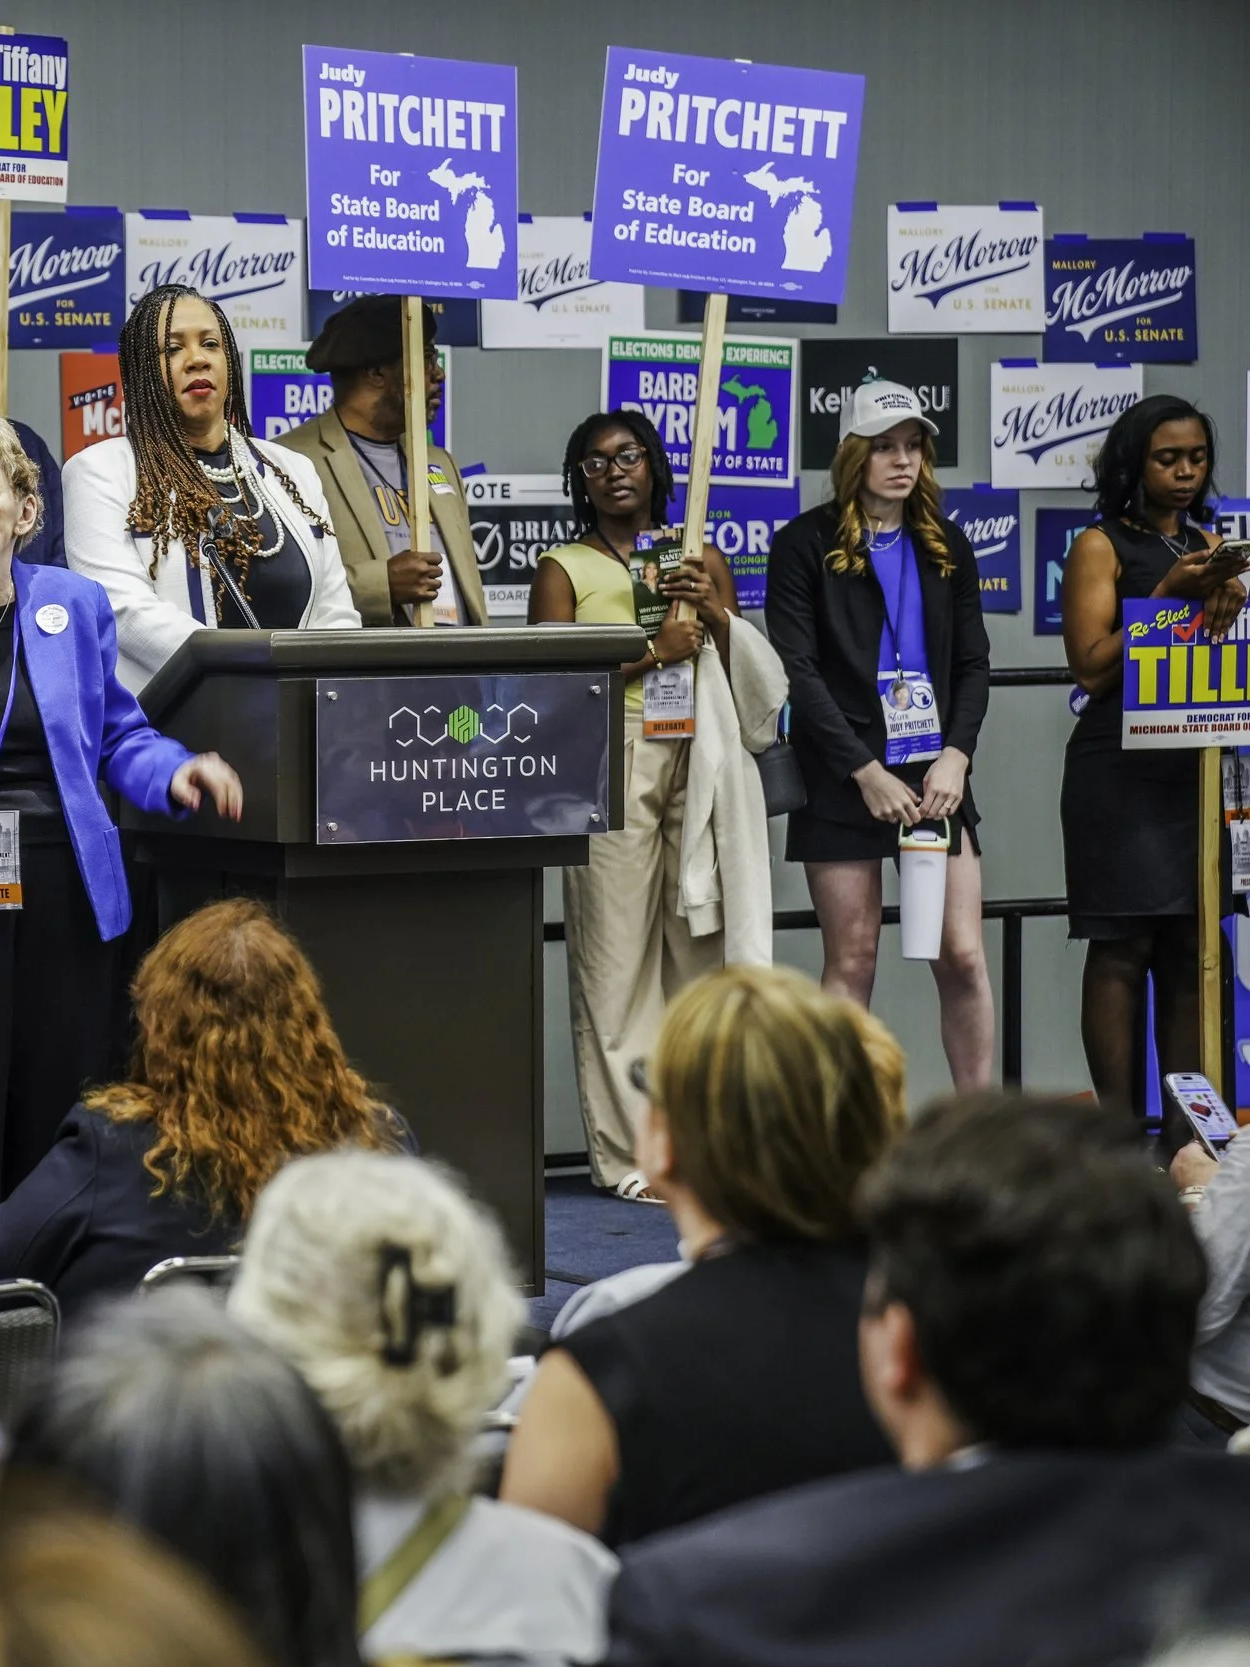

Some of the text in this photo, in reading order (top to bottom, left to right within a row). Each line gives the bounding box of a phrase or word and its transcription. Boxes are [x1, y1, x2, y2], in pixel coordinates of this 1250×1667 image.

[319, 62, 366, 87] Judy
[624, 64, 679, 89] Judy
[320, 87, 506, 153] PRITCHETT
[618, 87, 848, 159] PRITCHETT
[13, 162, 26, 173] FOR
[370, 164, 401, 187] For
[673, 163, 710, 187] For
[18, 173, 26, 184] OF
[28, 175, 63, 187] EDUCATION
[331, 193, 440, 221] State Board
[622, 189, 754, 222] State Board
[327, 224, 445, 253] of Education
[614, 219, 756, 254] of Education
[891, 228, 1039, 292] McMorrow
[1053, 260, 1096, 270] MALLORY
[56, 300, 74, 308] FOR
[984, 299, 1032, 310] SENATE
[1045, 259, 1192, 326] McMorrow
[19, 312, 111, 326] U.S. SENATE
[232, 318, 287, 330] SENATE
[1136, 317, 1152, 325] FOR
[1104, 328, 1184, 342] U.S. SENATE
[612, 341, 789, 365] ELECTIONS EXPERIENCE
[639, 370, 698, 401] BARB
[285, 384, 334, 414] BAR
[810, 387, 854, 414] Kell
[726, 455, 742, 468] OF
[746, 456, 783, 471] STATE
[733, 555, 767, 565] CONGR
[1128, 604, 1190, 641] Re-Elect
[1129, 644, 1250, 704] TILL
[1130, 723, 1240, 735] MICHIGAN STATE BOARD
[1187, 713, 1235, 723] DEMOCRAT
[370, 755, 557, 782] HUNTINGTON
[423, 789, 506, 813] PLACE
